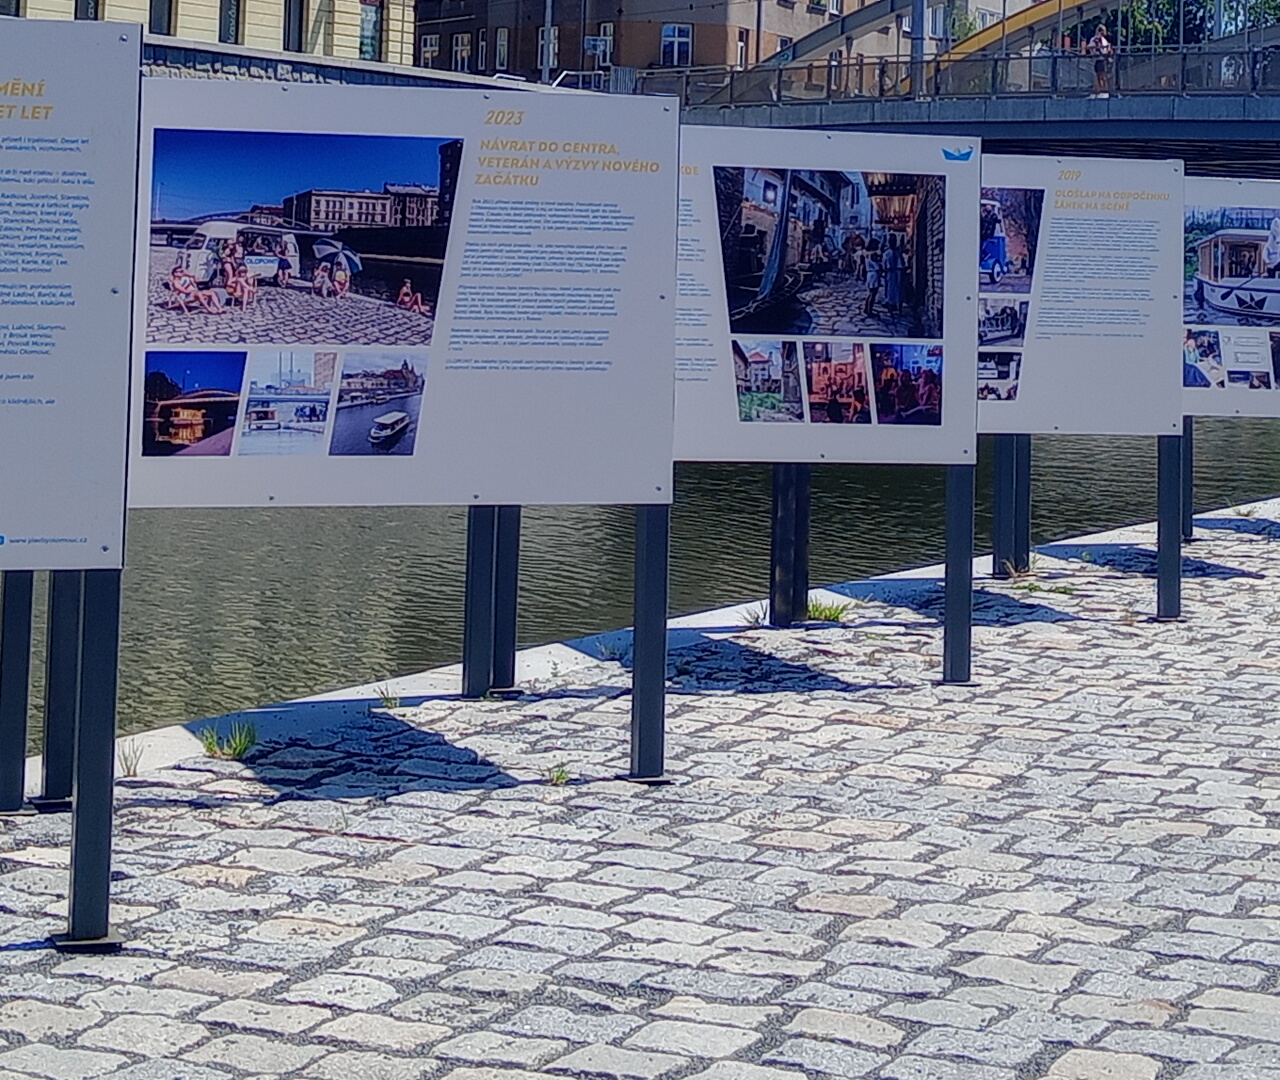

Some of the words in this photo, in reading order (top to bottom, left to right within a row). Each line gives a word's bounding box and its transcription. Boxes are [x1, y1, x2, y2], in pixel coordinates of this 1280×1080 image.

[21, 104, 53, 120] LET
[484, 110, 525, 126] 2023
[480, 137, 536, 152] NÁVRAT
[538, 141, 559, 153] DO
[477, 154, 540, 169] VETERÁN
[542, 159, 552, 169] A
[555, 156, 600, 170] VÝZVY
[602, 158, 660, 173] NOVÉHO
[474, 171, 539, 186] ZAČÁTKU
[1058, 170, 1082, 181] 2019
